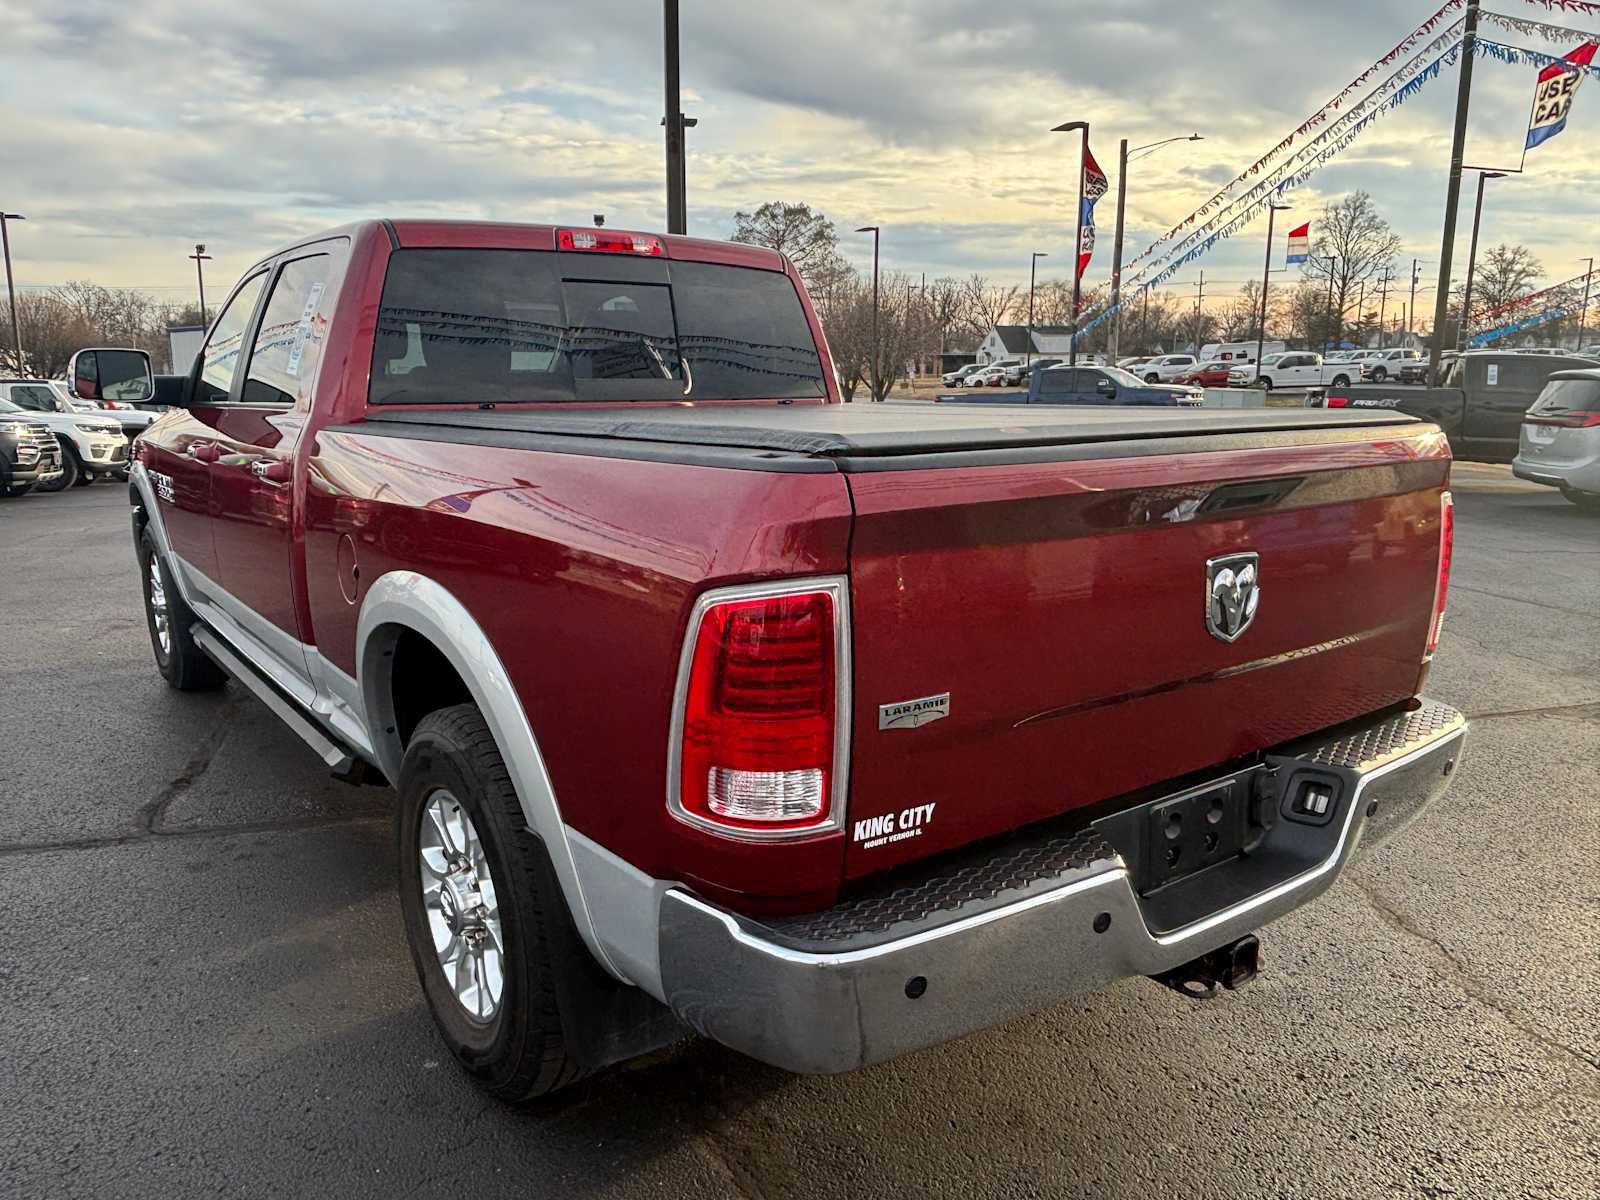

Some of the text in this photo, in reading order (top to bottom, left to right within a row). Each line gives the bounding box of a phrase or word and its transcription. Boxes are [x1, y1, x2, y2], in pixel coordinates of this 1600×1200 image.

[884, 699, 946, 717] LARAMIE
[853, 802, 936, 842] KING CITY
[863, 836, 888, 849] MOUNT
[888, 829, 915, 843] VERNON
